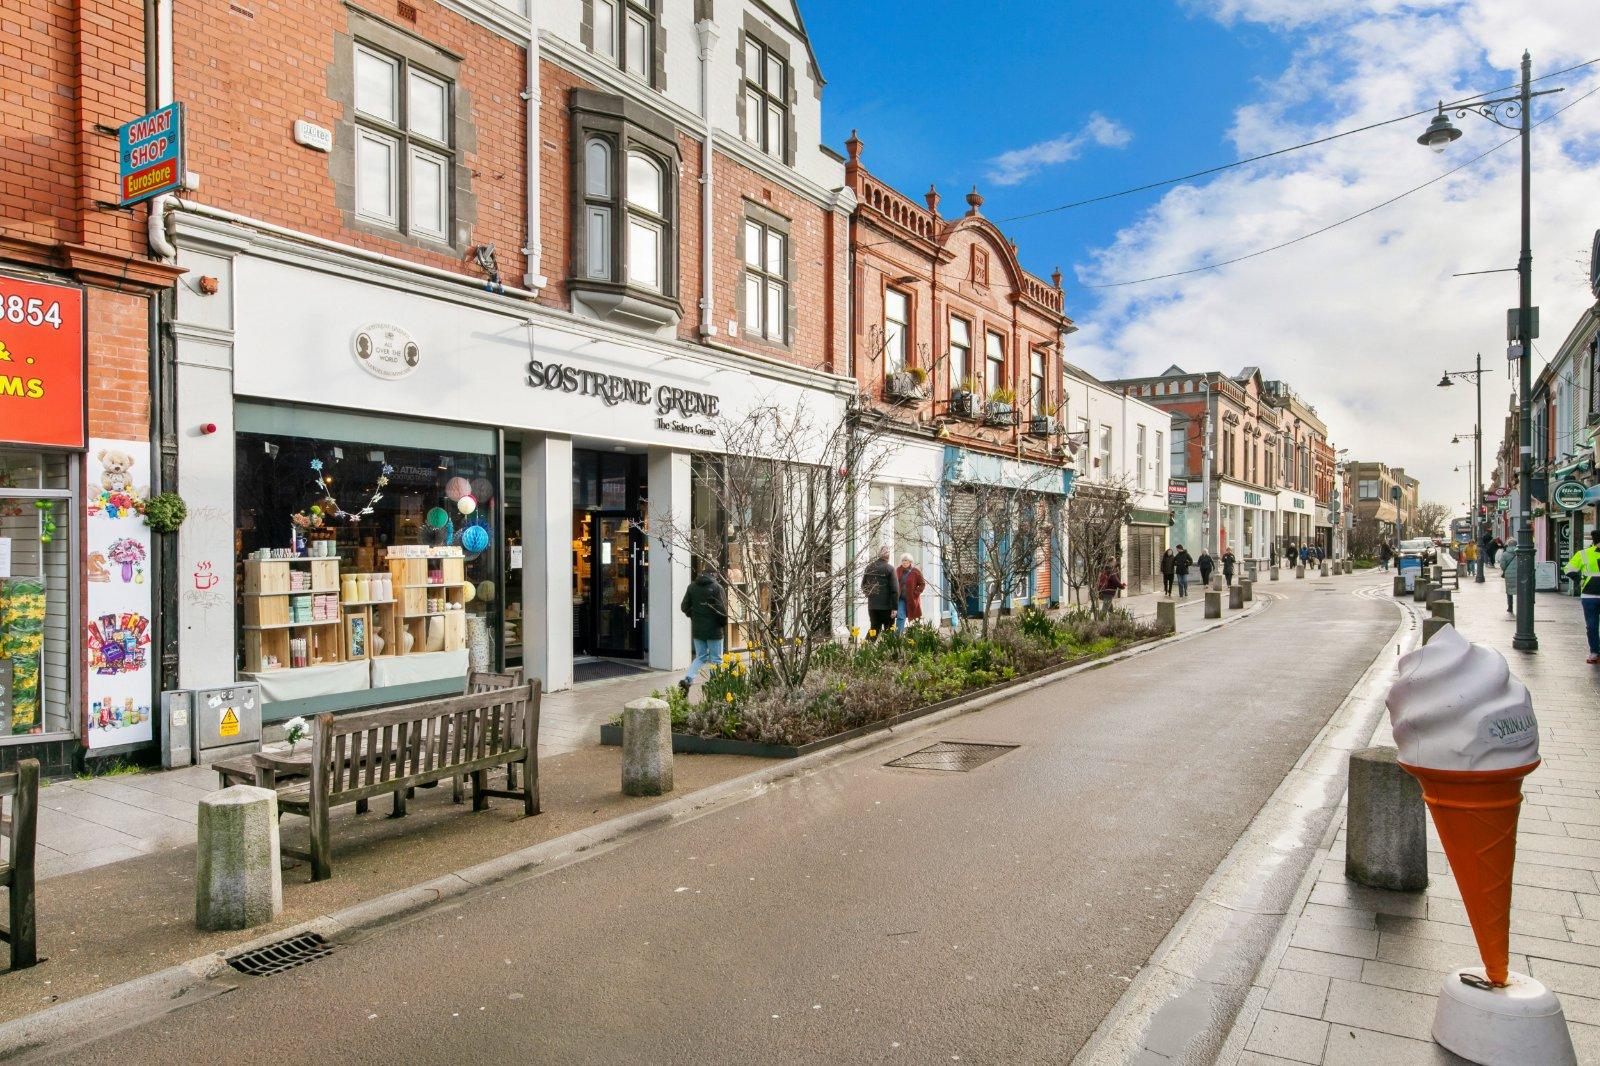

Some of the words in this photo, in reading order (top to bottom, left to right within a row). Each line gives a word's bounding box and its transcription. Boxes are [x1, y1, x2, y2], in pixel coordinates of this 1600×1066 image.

[129, 109, 172, 144] SMART
[131, 137, 167, 168] SHOP
[128, 166, 171, 192] Eurostore
[0, 293, 62, 330] 854
[528, 360, 652, 407] SØSTRENE
[657, 385, 720, 418] GRENE
[657, 417, 670, 430] The
[672, 420, 694, 433] Sisters
[694, 423, 716, 436] Grene
